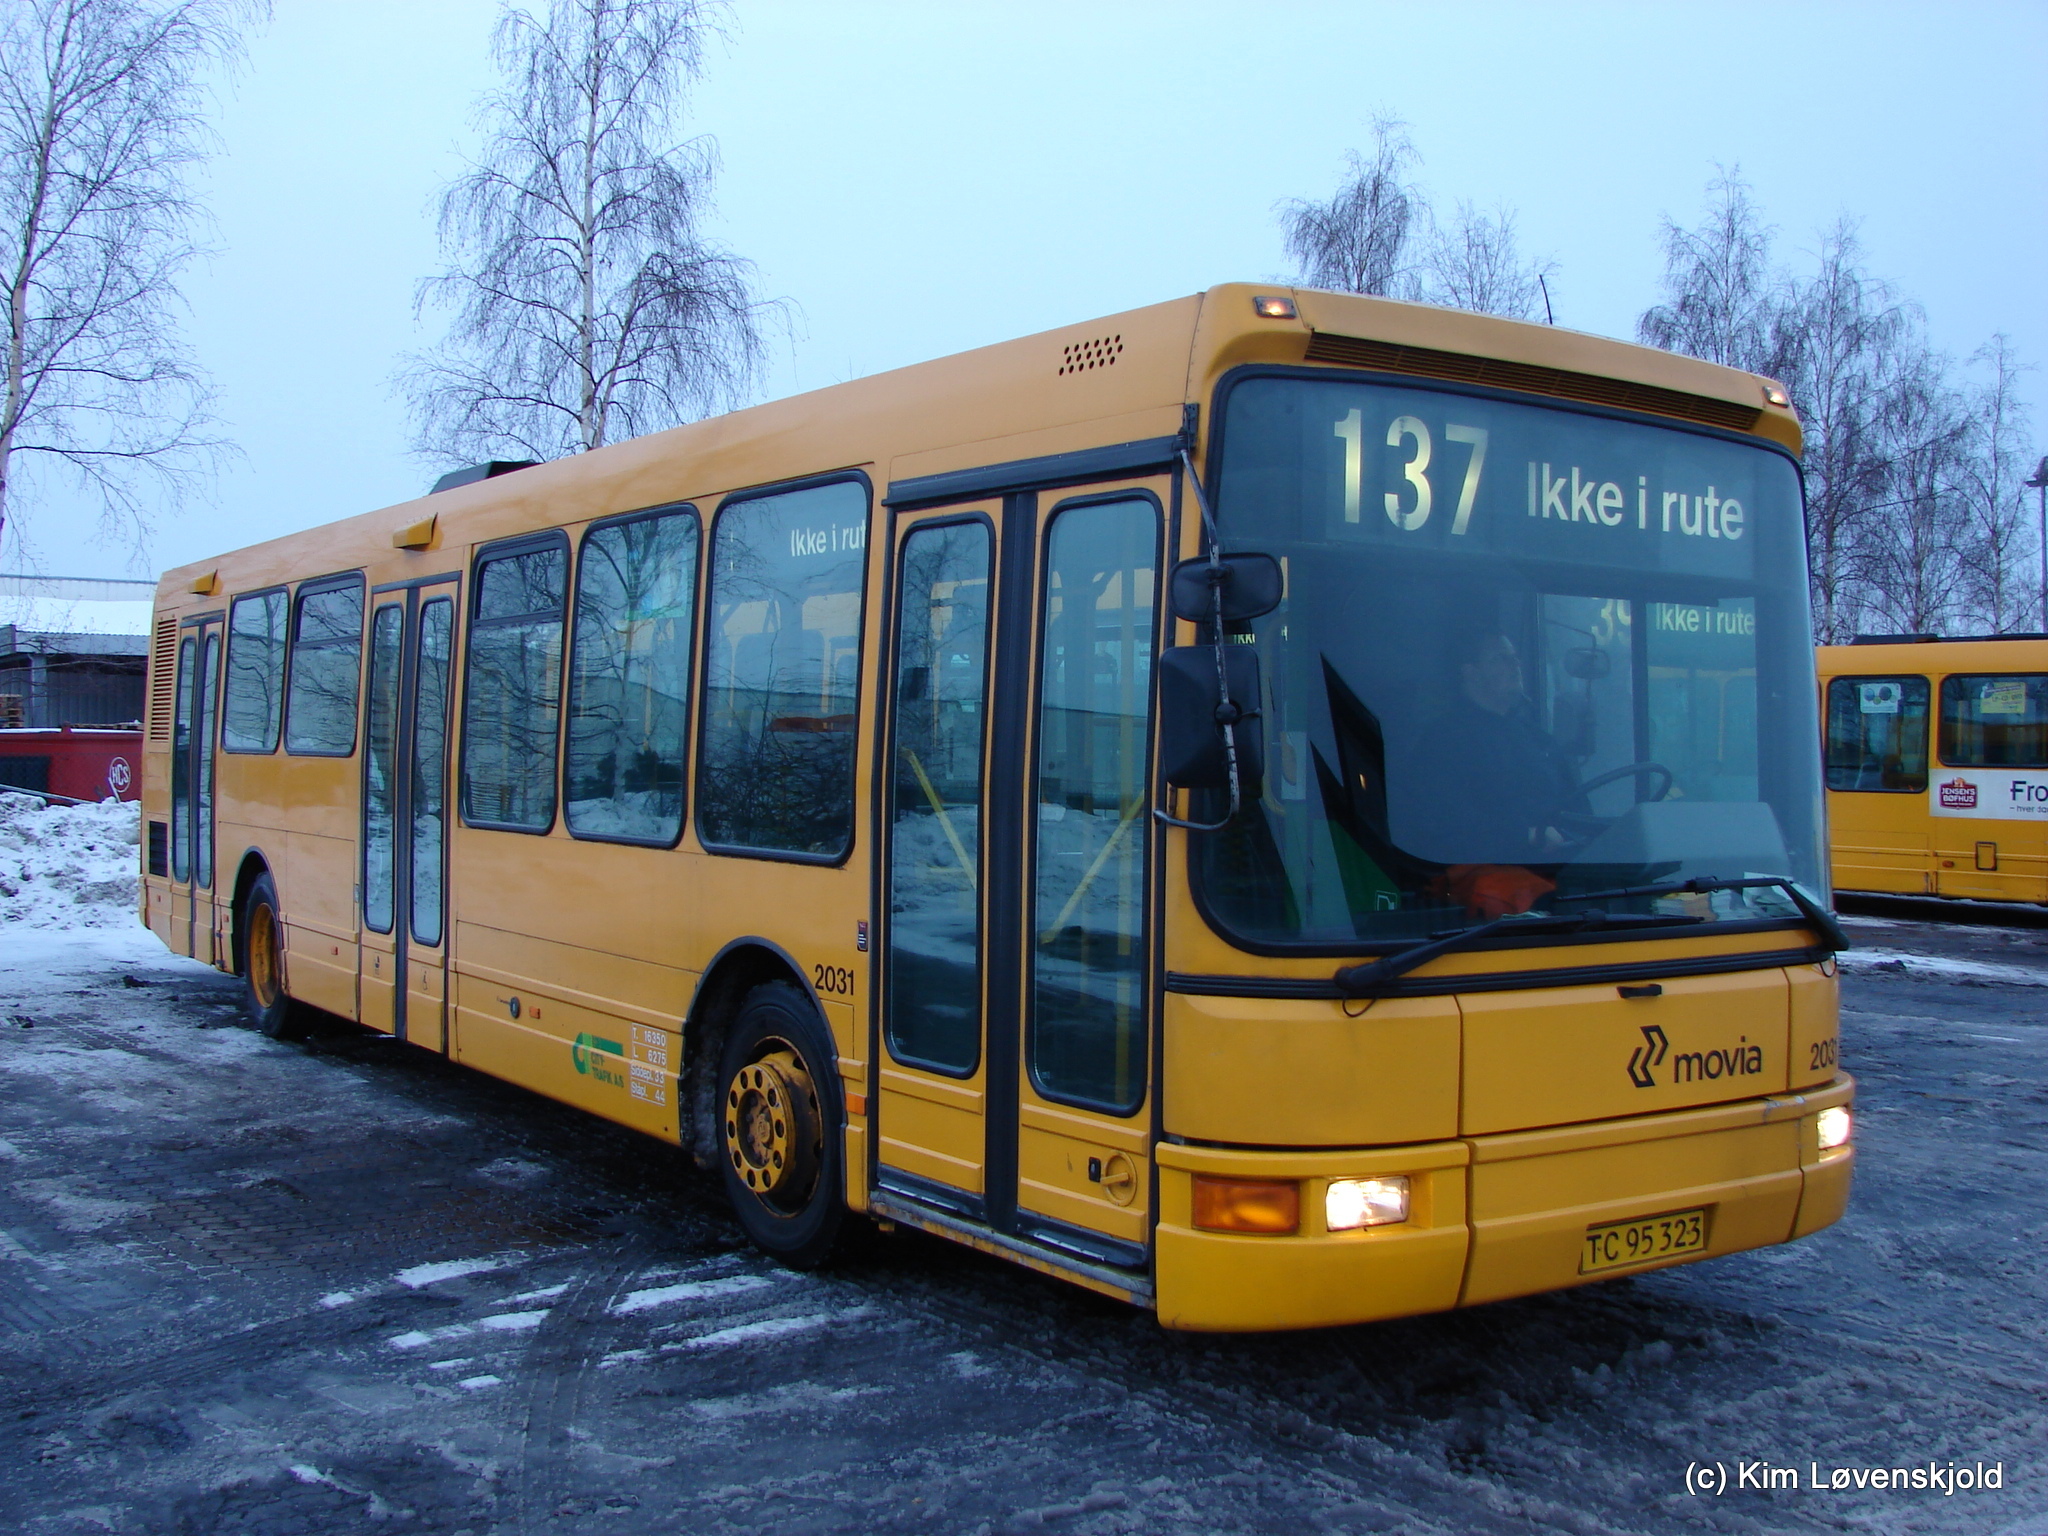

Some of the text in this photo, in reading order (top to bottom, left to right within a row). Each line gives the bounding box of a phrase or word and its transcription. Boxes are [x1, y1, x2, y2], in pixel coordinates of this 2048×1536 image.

[1334, 408, 1744, 541] 137 Ikke i rute
[790, 527, 827, 557] Ikke
[831, 523, 837, 552] i
[1655, 602, 1699, 632] Ikke
[1705, 606, 1710, 633] i
[1717, 607, 1755, 635] rute
[112, 764, 129, 785] HCS
[1942, 787, 1975, 795] JENSEN'S
[814, 964, 855, 996] 2031
[644, 1030, 666, 1047] 16350
[648, 1049, 666, 1066] 6275
[1673, 1036, 1763, 1083] movia
[655, 1089, 666, 1103] 44
[1586, 1231, 1619, 1264] TC
